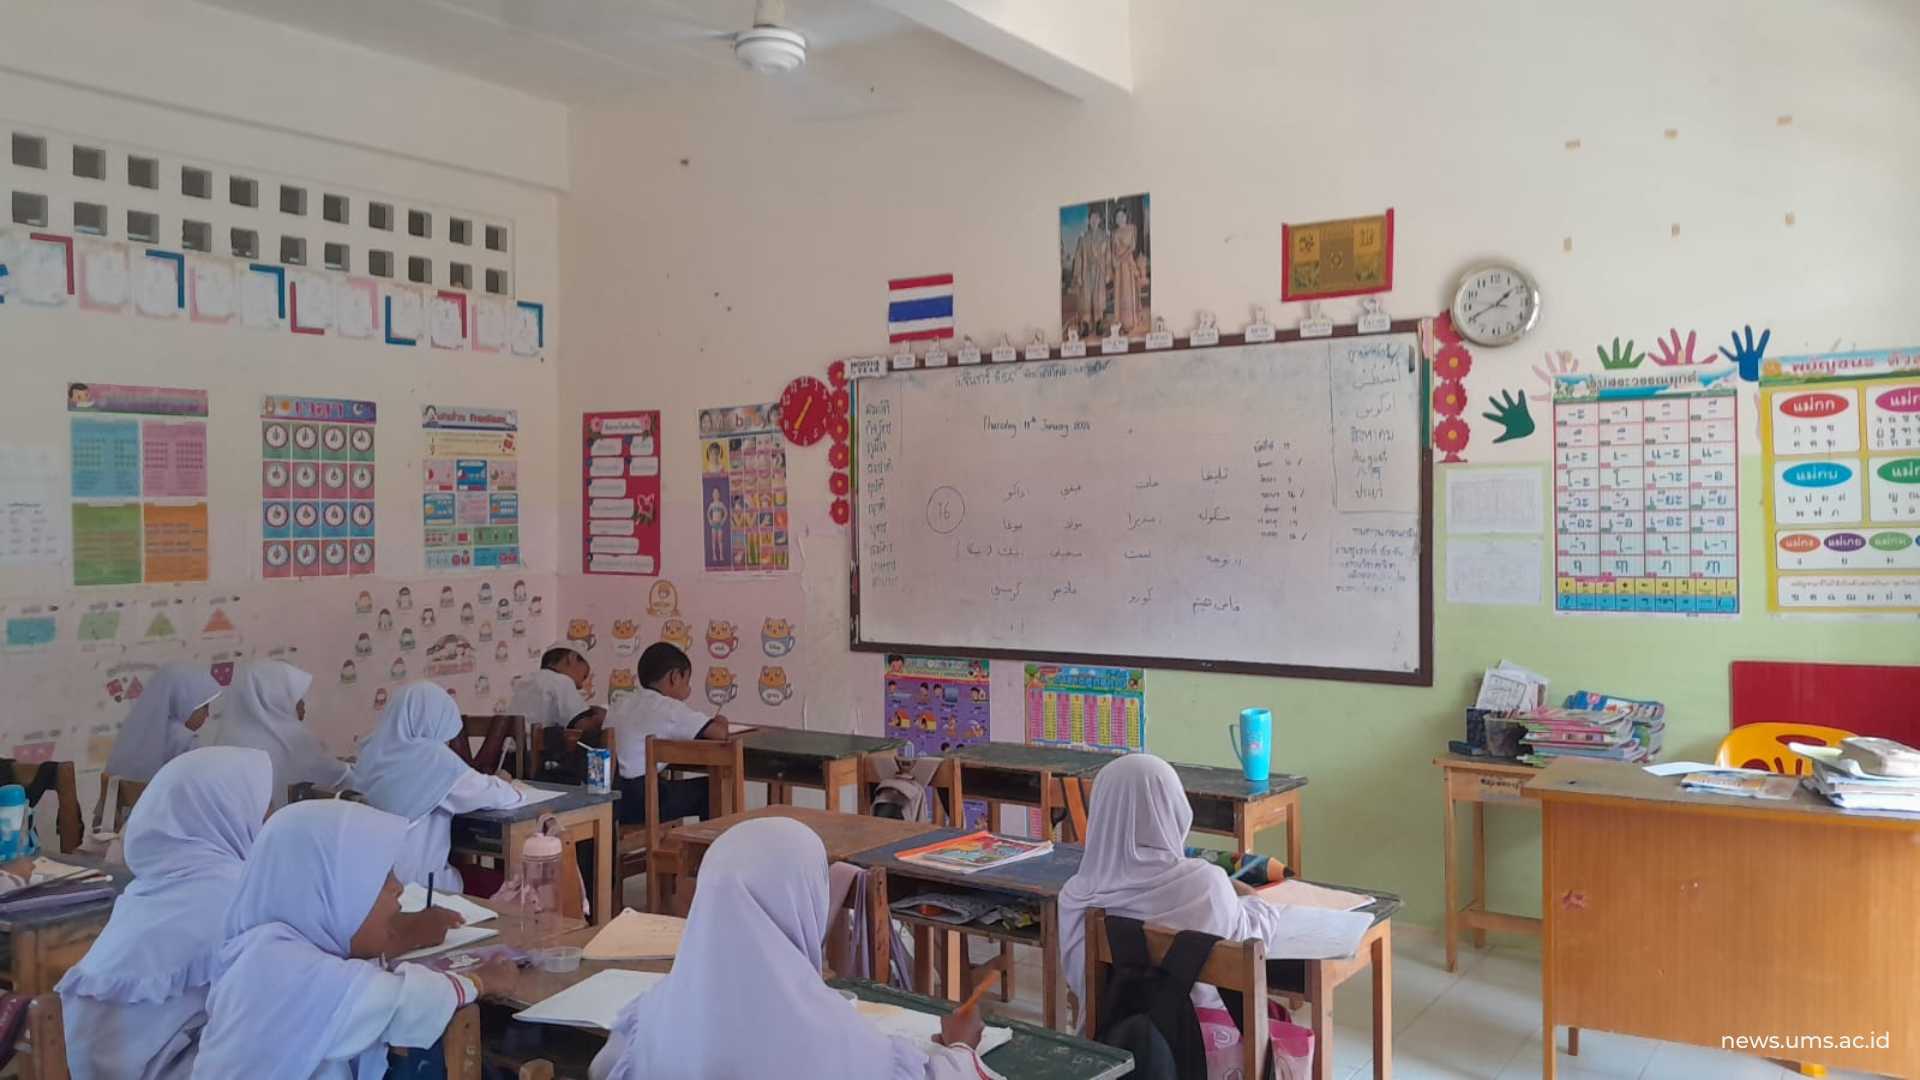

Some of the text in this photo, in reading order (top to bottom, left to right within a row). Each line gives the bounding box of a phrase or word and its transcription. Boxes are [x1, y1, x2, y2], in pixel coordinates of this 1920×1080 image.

[1793, 392, 1836, 412] แม่กก
[983, 414, 1017, 439] Thursday
[1040, 418, 1069, 438] January
[1351, 447, 1388, 469] August
